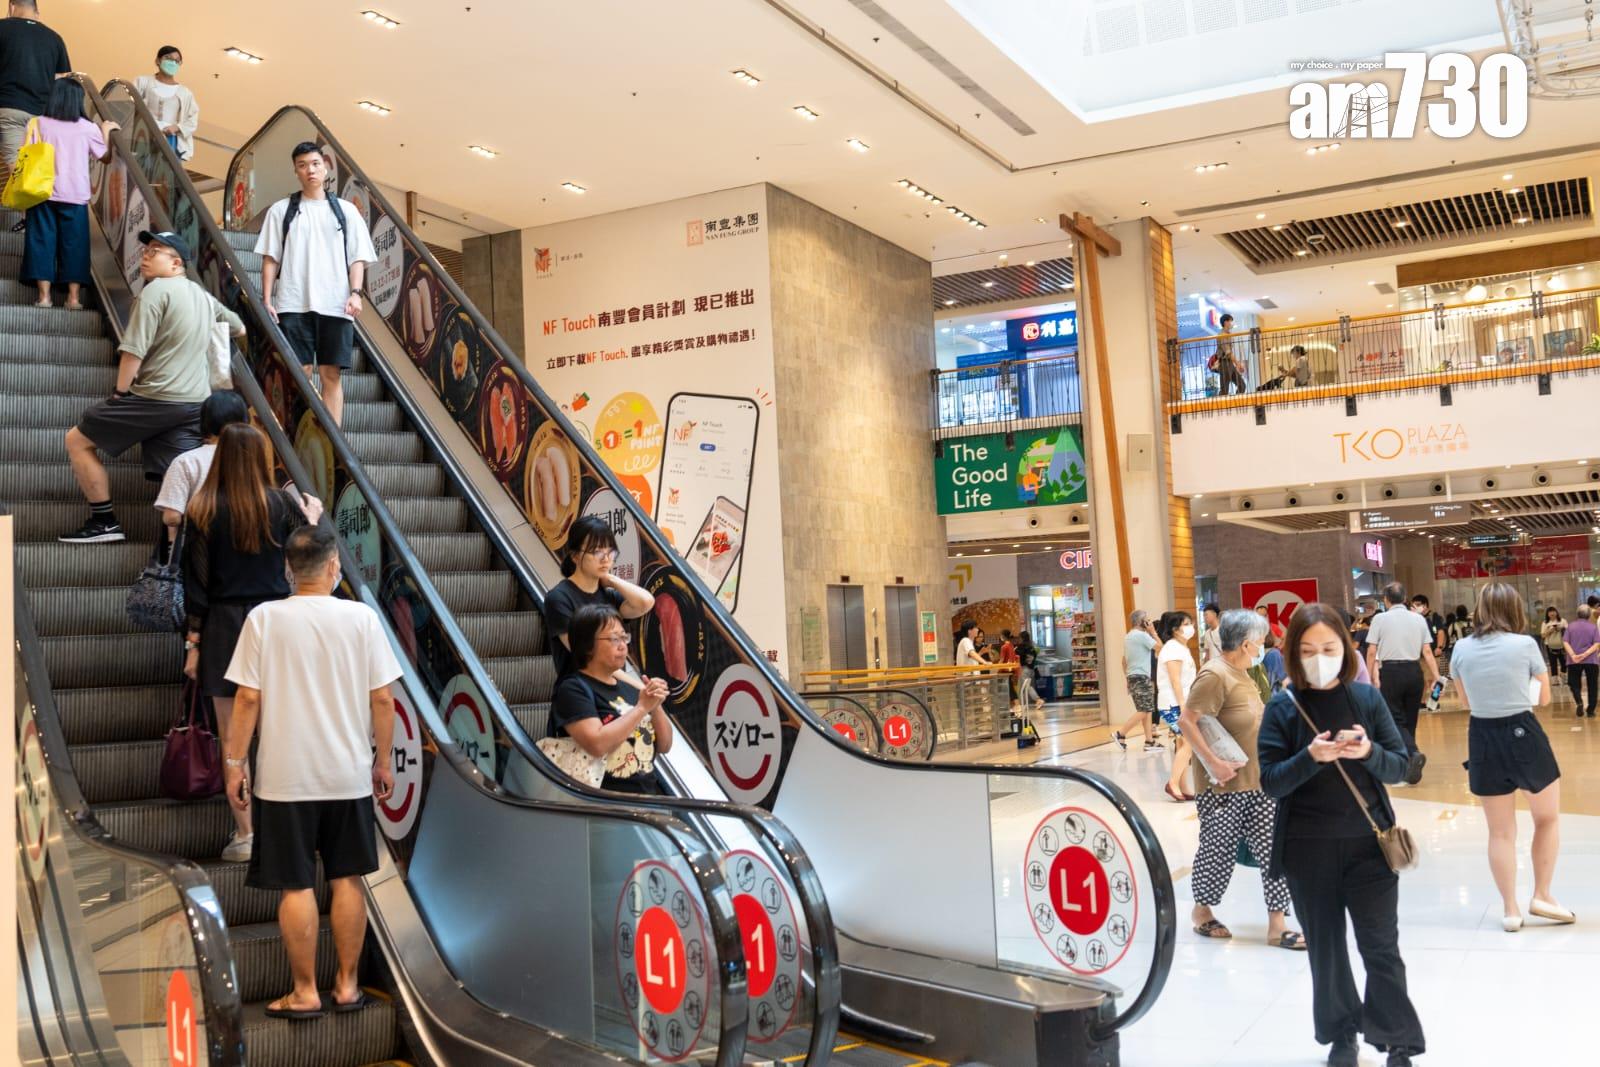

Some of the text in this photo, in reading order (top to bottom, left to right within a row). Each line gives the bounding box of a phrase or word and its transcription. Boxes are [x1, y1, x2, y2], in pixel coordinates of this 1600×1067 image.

[543, 319, 557, 335] NF
[694, 288, 755, 313] 現已推出
[1041, 317, 1078, 338] 利嘉
[634, 419, 643, 438] 1
[1407, 423, 1467, 444] PLAZA
[950, 443, 988, 464] The
[951, 462, 1008, 487] Good
[953, 488, 992, 510] Life
[1267, 602, 1299, 629] K
[713, 720, 775, 750] スシロー
[889, 723, 907, 740] L1
[1060, 868, 1098, 914] L1
[643, 932, 676, 989] L1
[171, 1000, 192, 1067] L1
